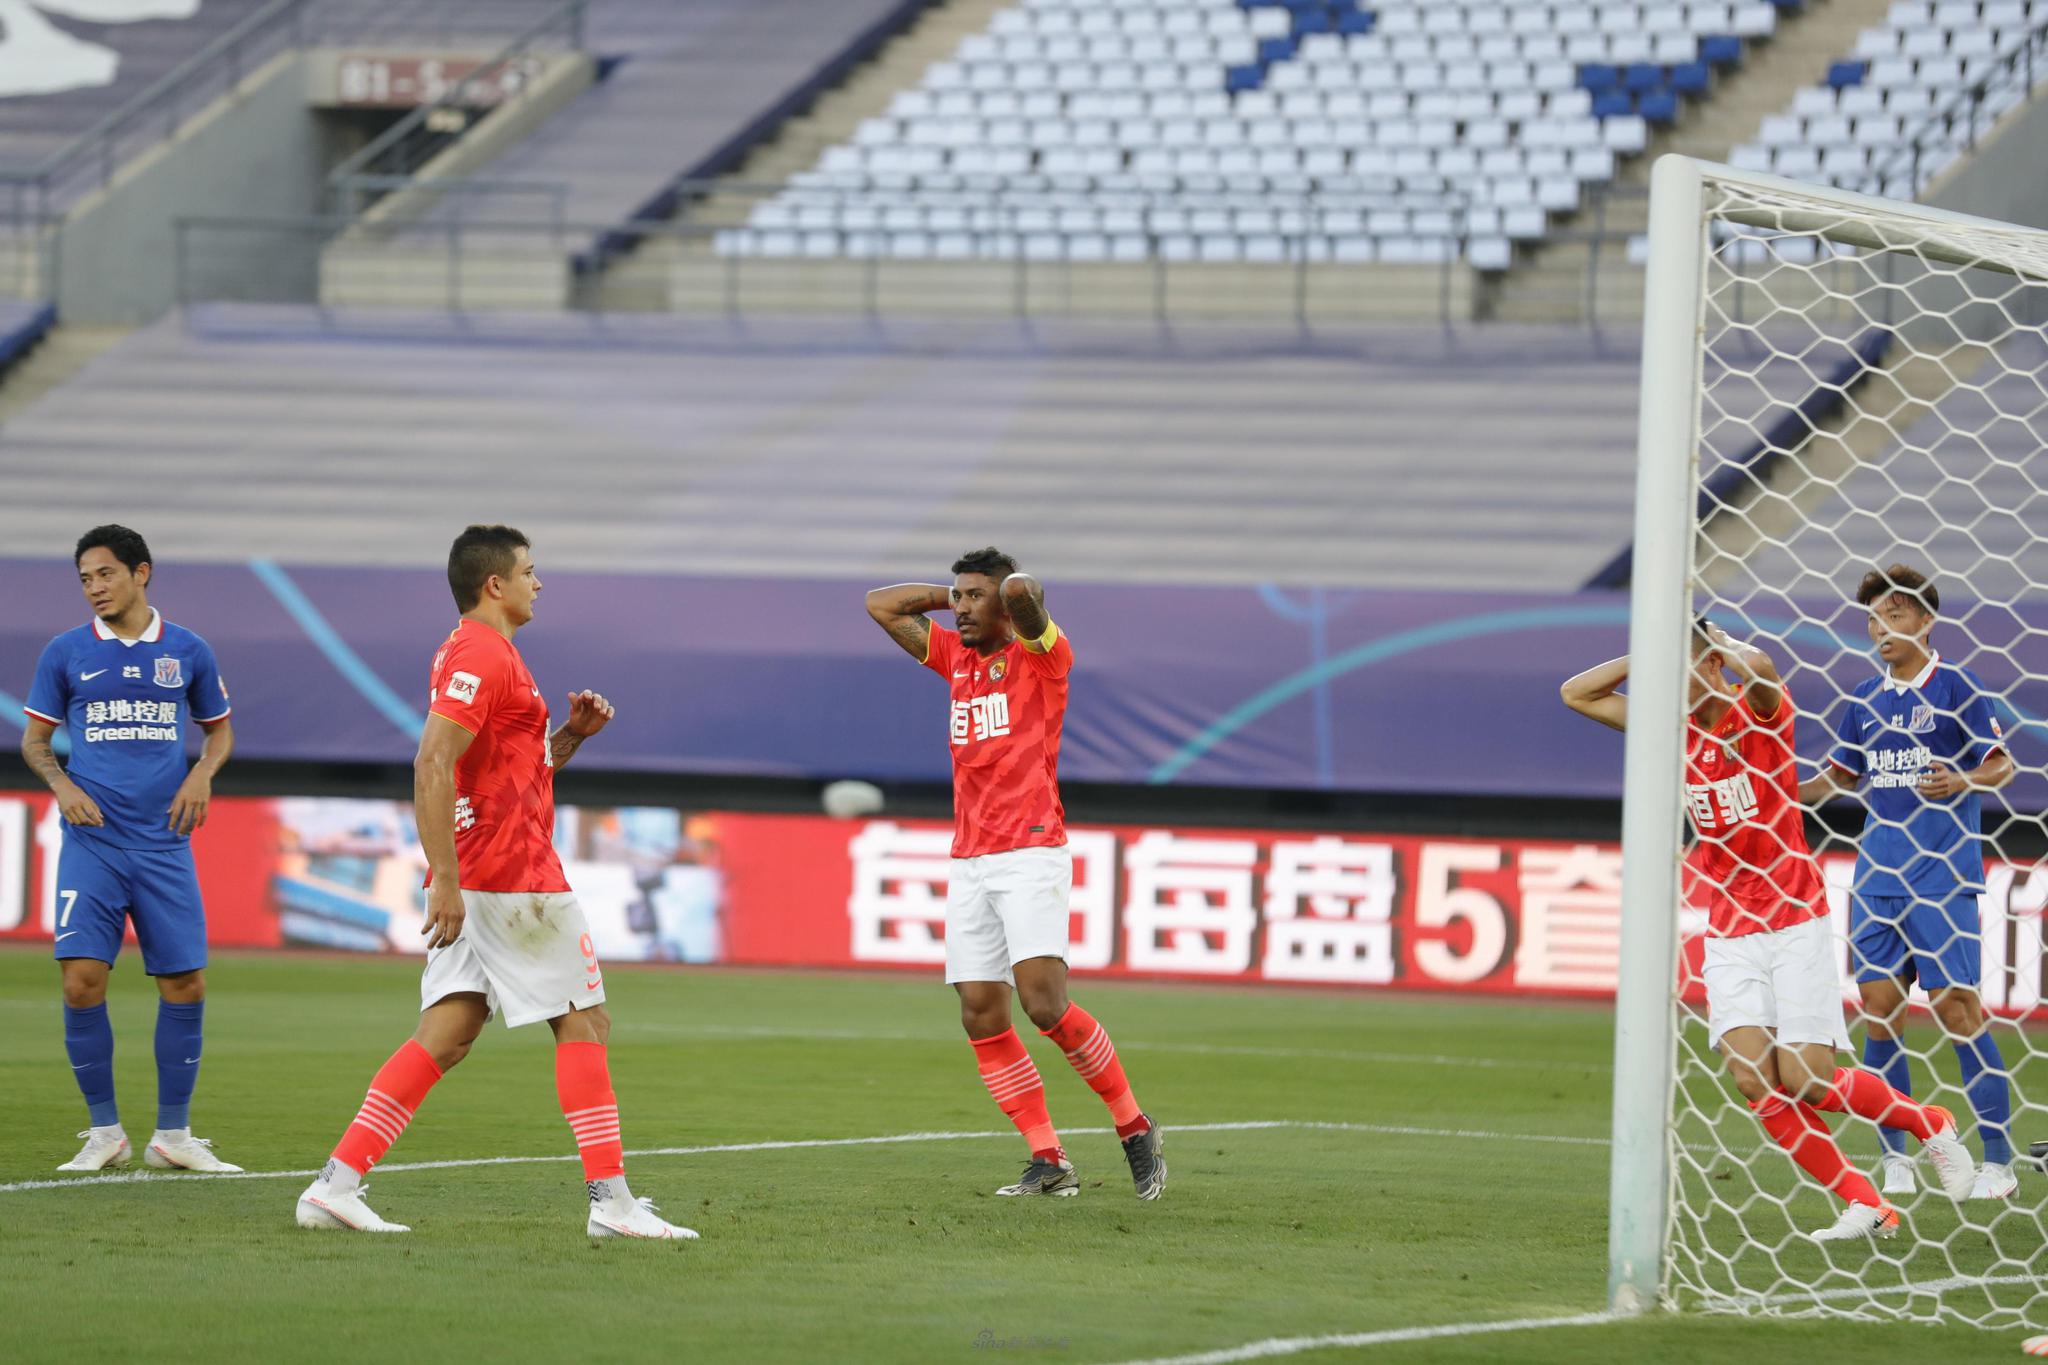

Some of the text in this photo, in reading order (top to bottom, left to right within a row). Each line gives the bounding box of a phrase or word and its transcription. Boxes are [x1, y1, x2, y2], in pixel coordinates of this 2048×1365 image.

[86, 700, 178, 724] 绿地控股
[85, 725, 178, 742] Greenland
[60, 889, 78, 927] 7
[579, 933, 598, 973] 9
